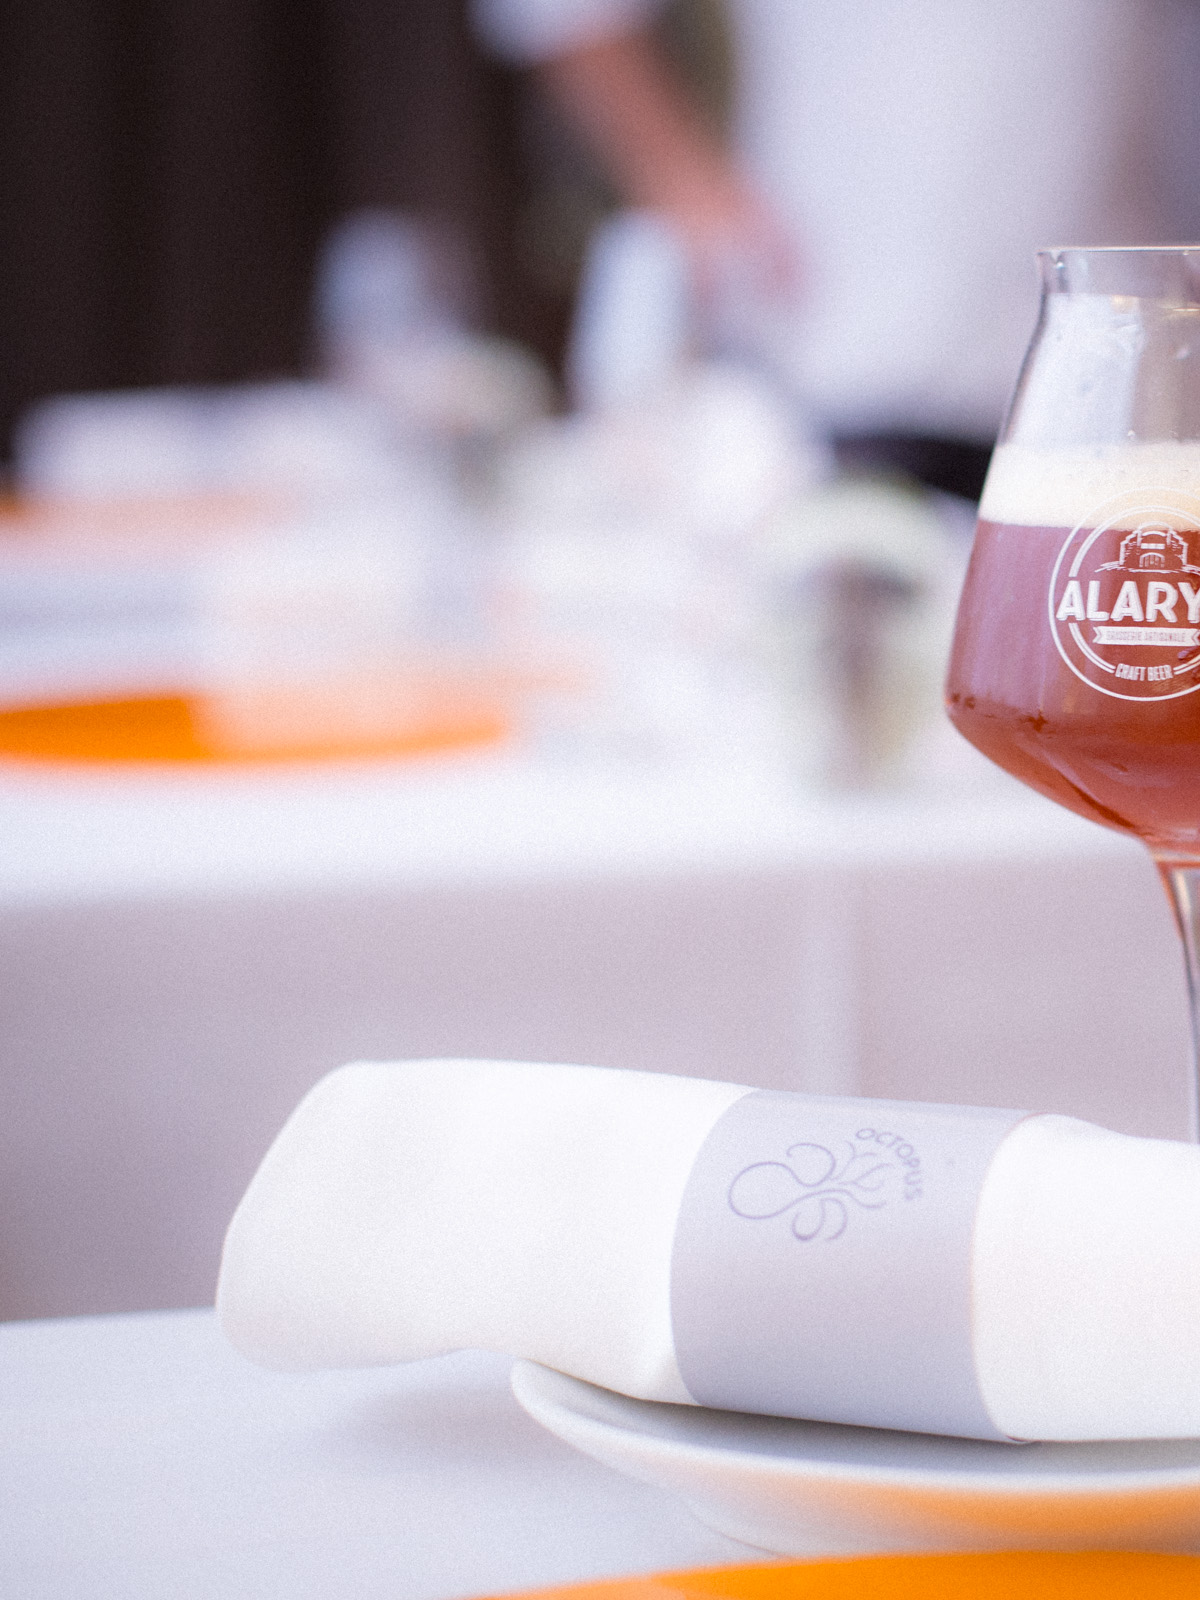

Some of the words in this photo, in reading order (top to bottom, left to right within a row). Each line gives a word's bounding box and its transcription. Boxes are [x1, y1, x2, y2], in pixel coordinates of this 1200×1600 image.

[1115, 662, 1146, 681] CRAFT
[1147, 664, 1174, 681] BEER
[855, 1127, 922, 1200] OCTOPUS
